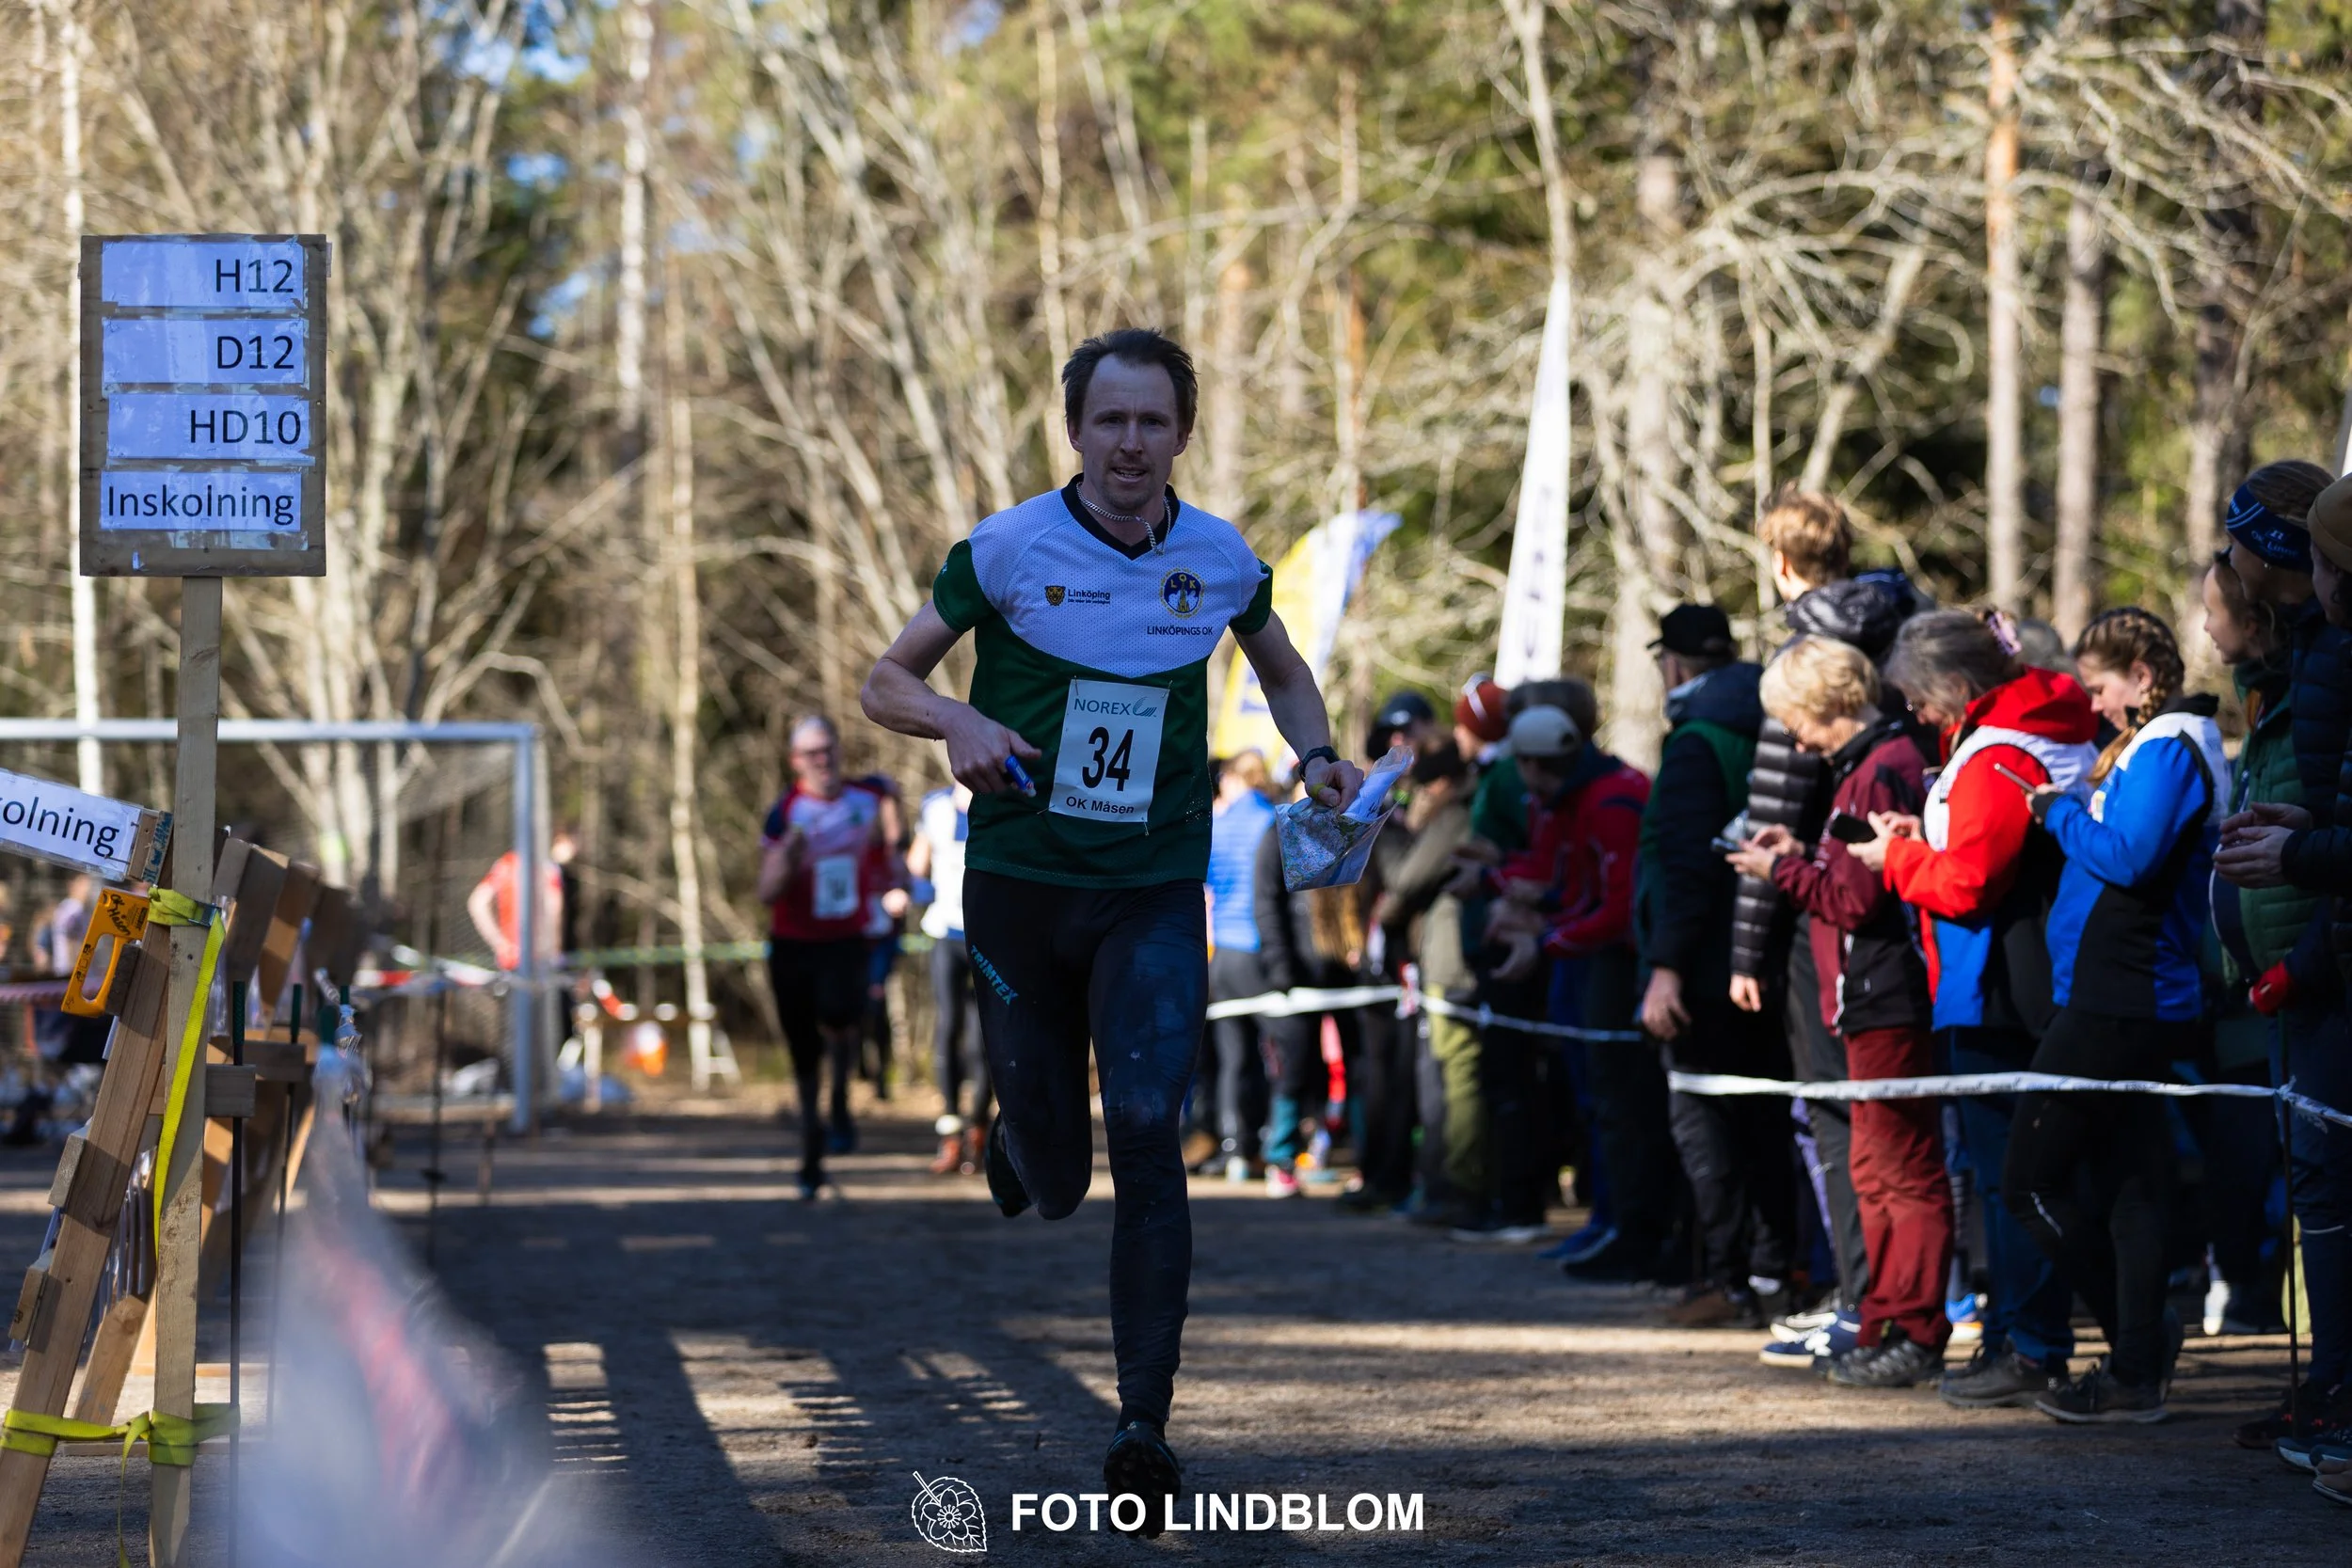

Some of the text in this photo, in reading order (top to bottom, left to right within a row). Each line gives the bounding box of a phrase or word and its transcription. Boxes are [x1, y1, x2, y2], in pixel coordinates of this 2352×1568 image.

[215, 259, 294, 293] H12
[216, 335, 294, 370] D12
[190, 409, 301, 445] HD10
[108, 484, 294, 526] Inskolning
[1068, 588, 1111, 601] Linköping
[1147, 625, 1214, 636] LINKÖPINGS OK
[1074, 698, 1132, 716] NOREX
[1082, 726, 1135, 792] 34
[1066, 796, 1135, 815] OK Måsen
[0, 797, 120, 858] olning
[971, 944, 1019, 1006] TRIMTEX
